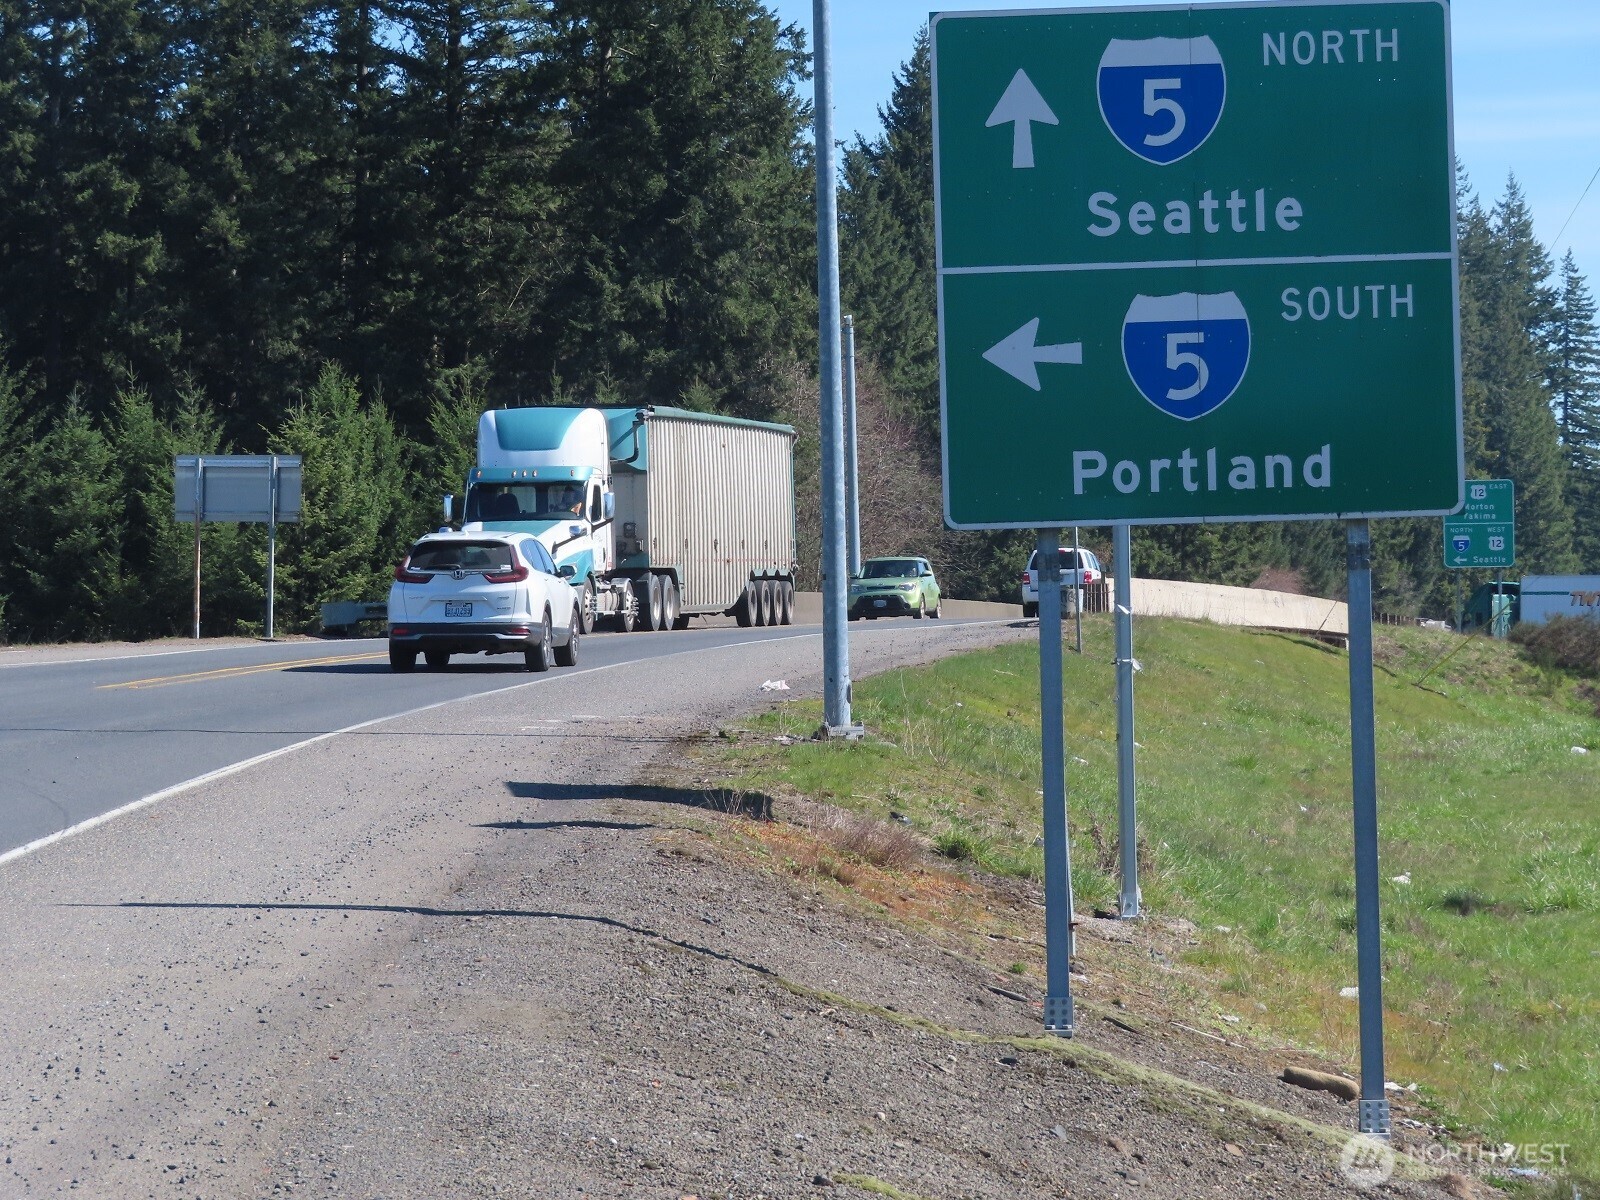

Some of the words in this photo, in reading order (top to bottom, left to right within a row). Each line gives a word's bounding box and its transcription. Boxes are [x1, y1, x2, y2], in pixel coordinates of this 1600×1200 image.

[1262, 28, 1399, 66] NORTH
[1143, 78, 1186, 147] 5
[1087, 188, 1303, 237] Seattle
[1281, 284, 1414, 321] SOUTH
[1166, 332, 1209, 400] 5
[1072, 444, 1331, 495] Portland
[1474, 488, 1485, 497] 12
[1458, 541, 1465, 551] 5
[1492, 539, 1502, 548] 12
